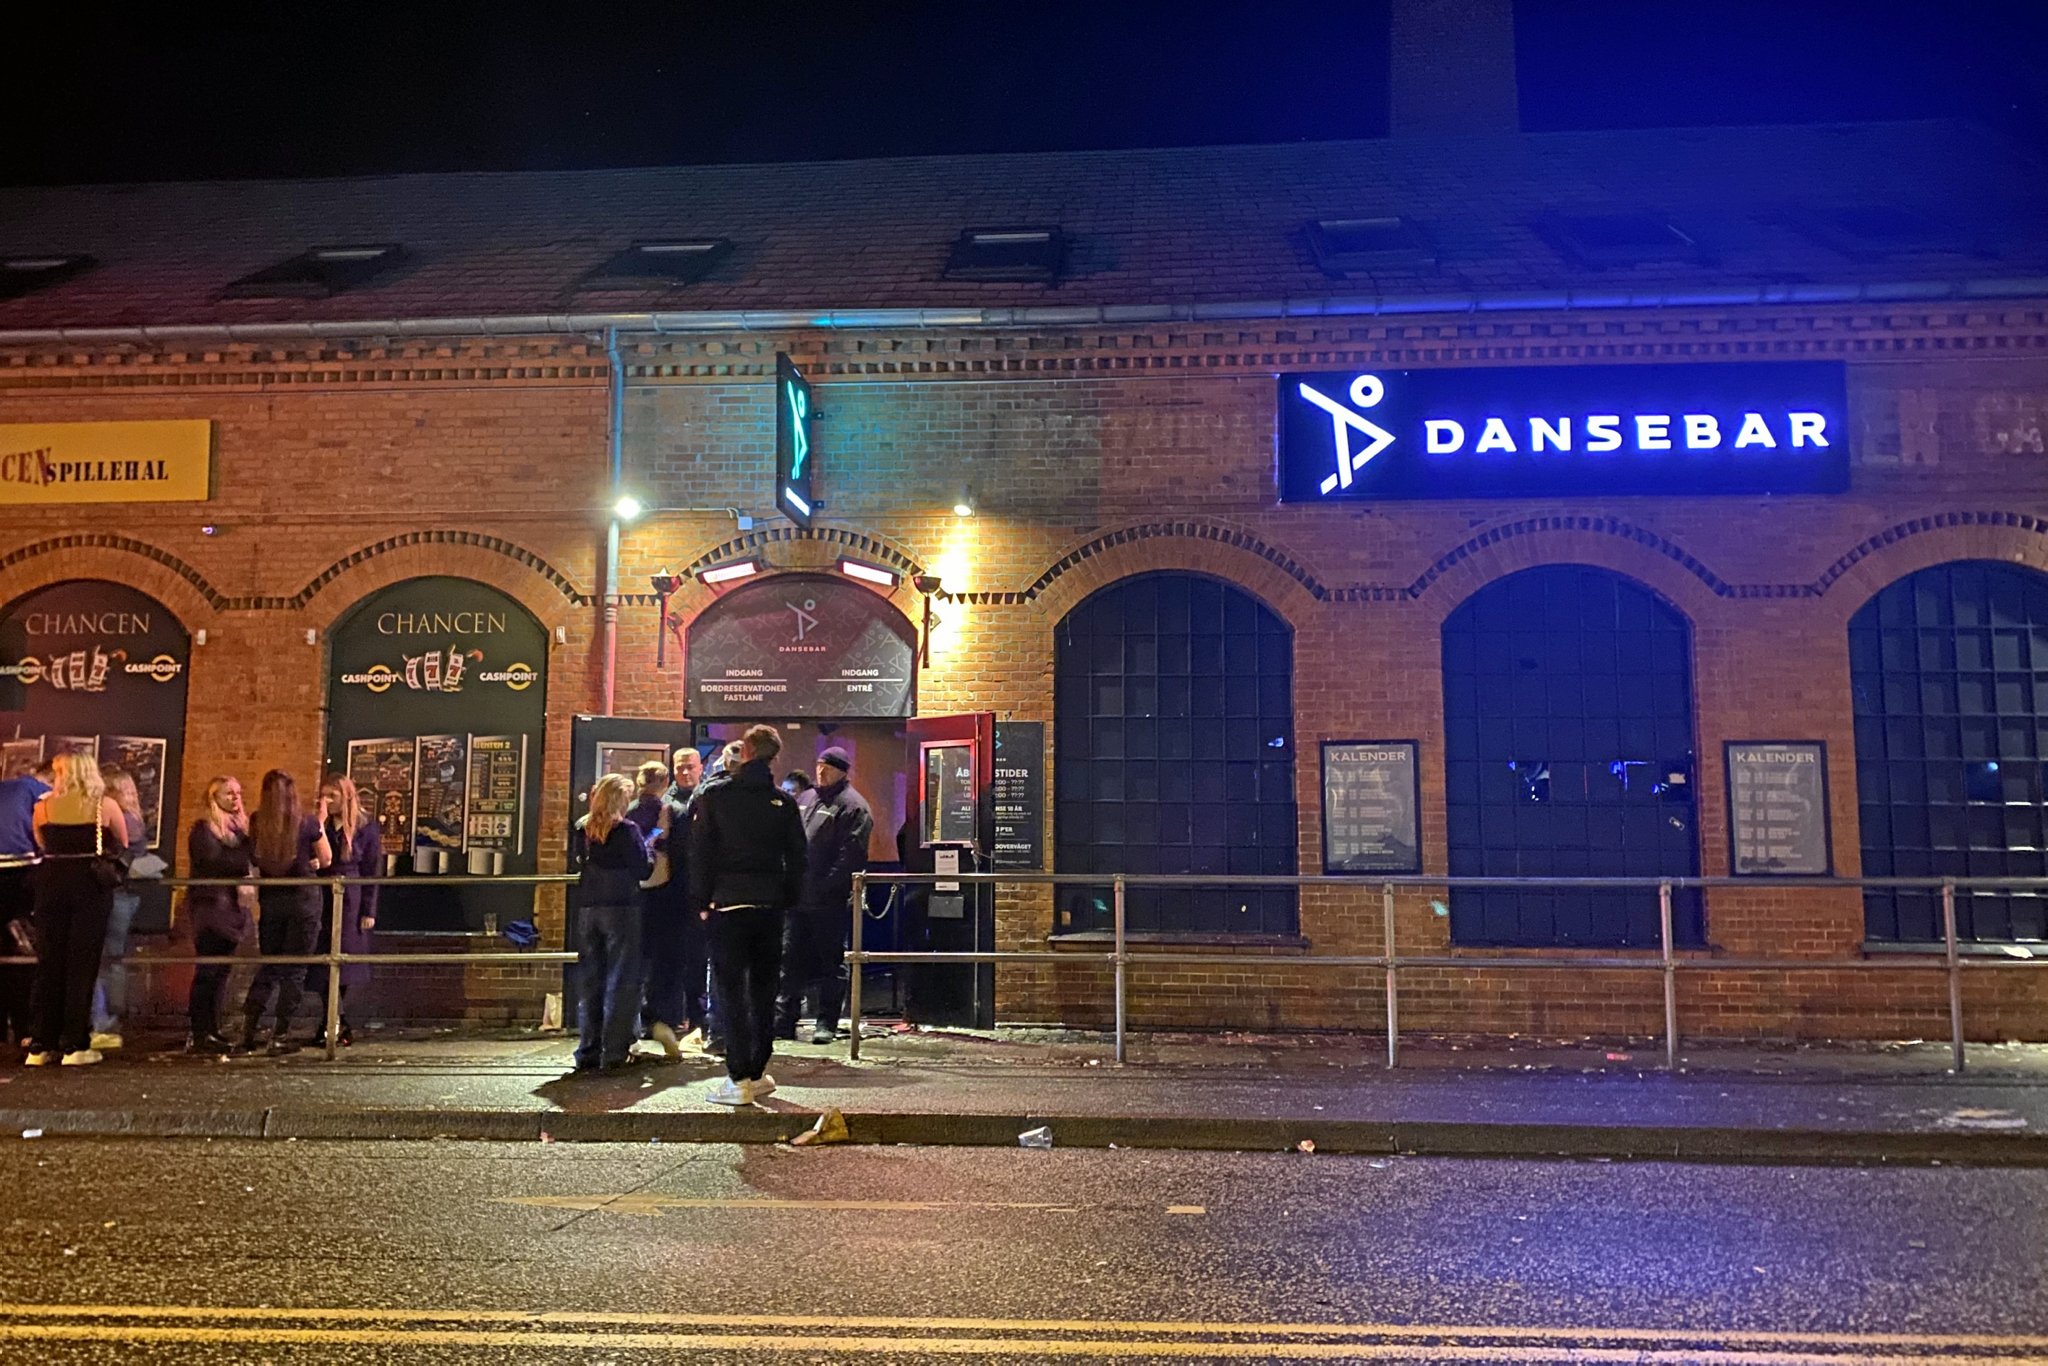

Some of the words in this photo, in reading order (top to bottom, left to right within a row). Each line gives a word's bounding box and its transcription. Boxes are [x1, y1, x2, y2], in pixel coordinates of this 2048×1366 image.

[1423, 411, 1831, 455] DANSEBAR
[47, 460, 169, 483] SPILLEHAL
[25, 613, 150, 635] CHANCEN
[377, 612, 506, 635] CHANCEN
[0, 664, 47, 676] ASHPOINT
[125, 663, 182, 673] CASHPOINT
[726, 669, 763, 677] INDGANG
[841, 669, 879, 677] INDGANG
[341, 673, 398, 684] CASHPOINT
[479, 671, 539, 681] CASHPOINT
[700, 684, 787, 693] BORDRESERVATIONER
[847, 683, 873, 693] ENTRÉ
[724, 694, 763, 702] FASTLANE
[1331, 751, 1406, 762] KALENDER
[1736, 752, 1815, 763] KALENDER
